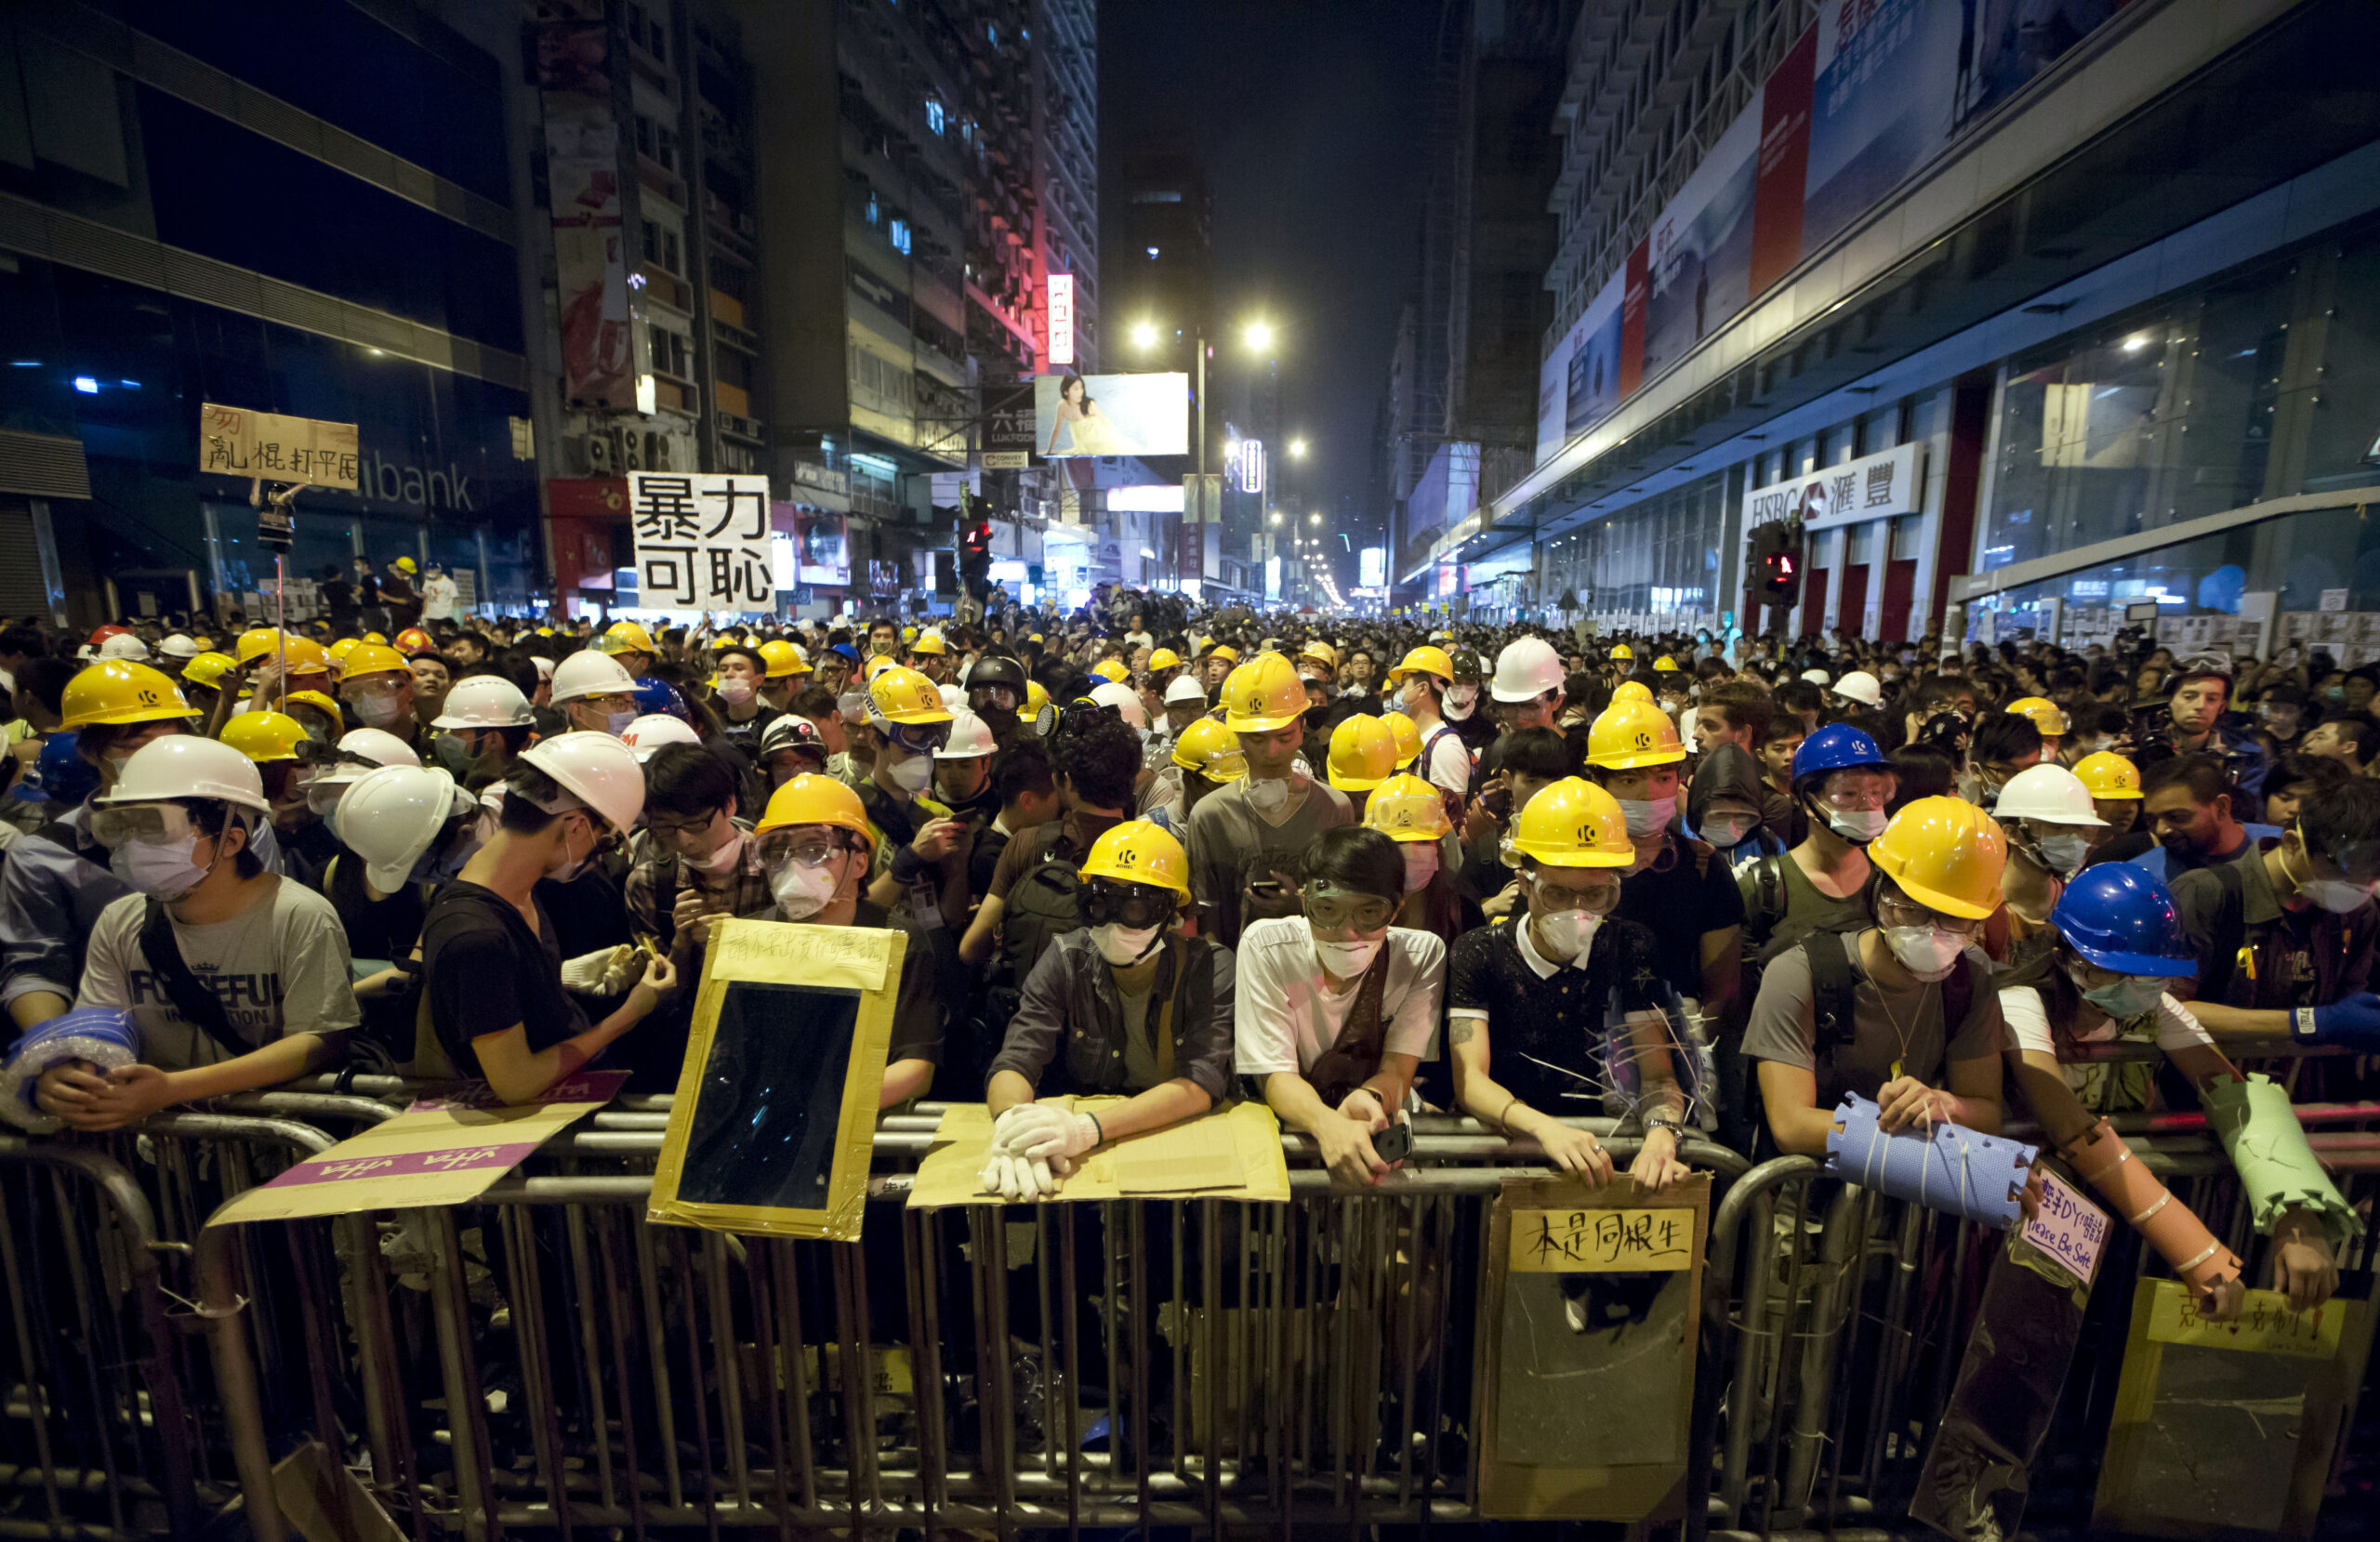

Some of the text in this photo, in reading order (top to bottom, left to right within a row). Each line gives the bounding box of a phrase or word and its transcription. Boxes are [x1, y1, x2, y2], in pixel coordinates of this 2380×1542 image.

[210, 409, 241, 434] 勿
[208, 435, 358, 480] 亂棍打平民
[635, 476, 765, 541] 暴力
[1753, 487, 1798, 528] HSBC
[638, 545, 773, 605] 可恥
[1525, 1212, 1689, 1265] 本是同根生
[2057, 1232, 2072, 1256] Be
[2072, 1242, 2091, 1270] Soft
